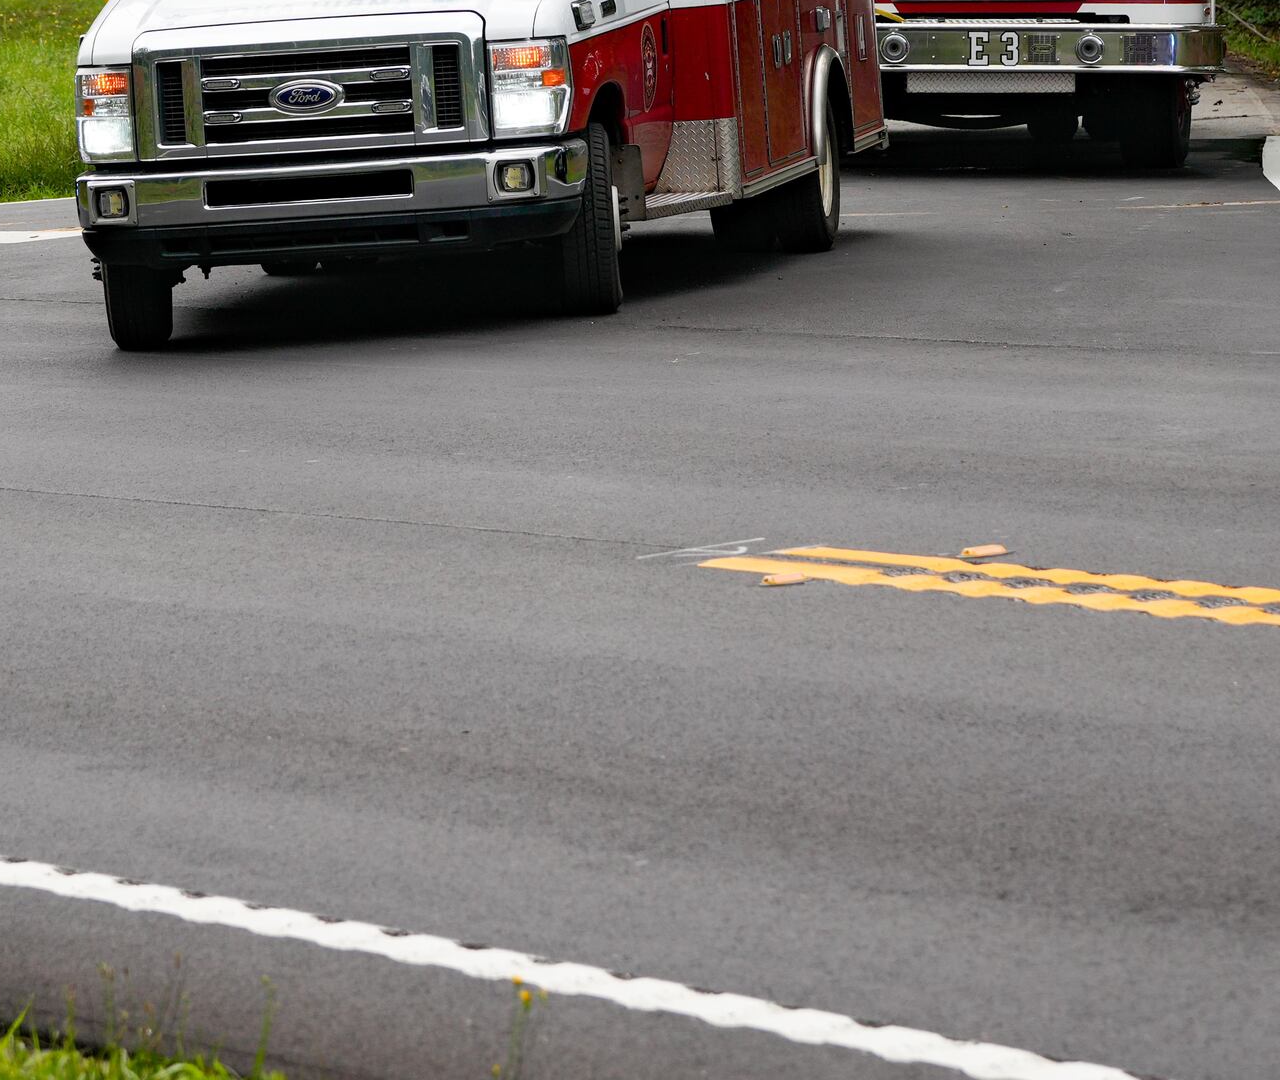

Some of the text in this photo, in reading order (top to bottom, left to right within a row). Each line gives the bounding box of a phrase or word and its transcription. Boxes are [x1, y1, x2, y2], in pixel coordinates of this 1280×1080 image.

[969, 31, 1020, 66] E 3
[288, 88, 321, 103] Ford
